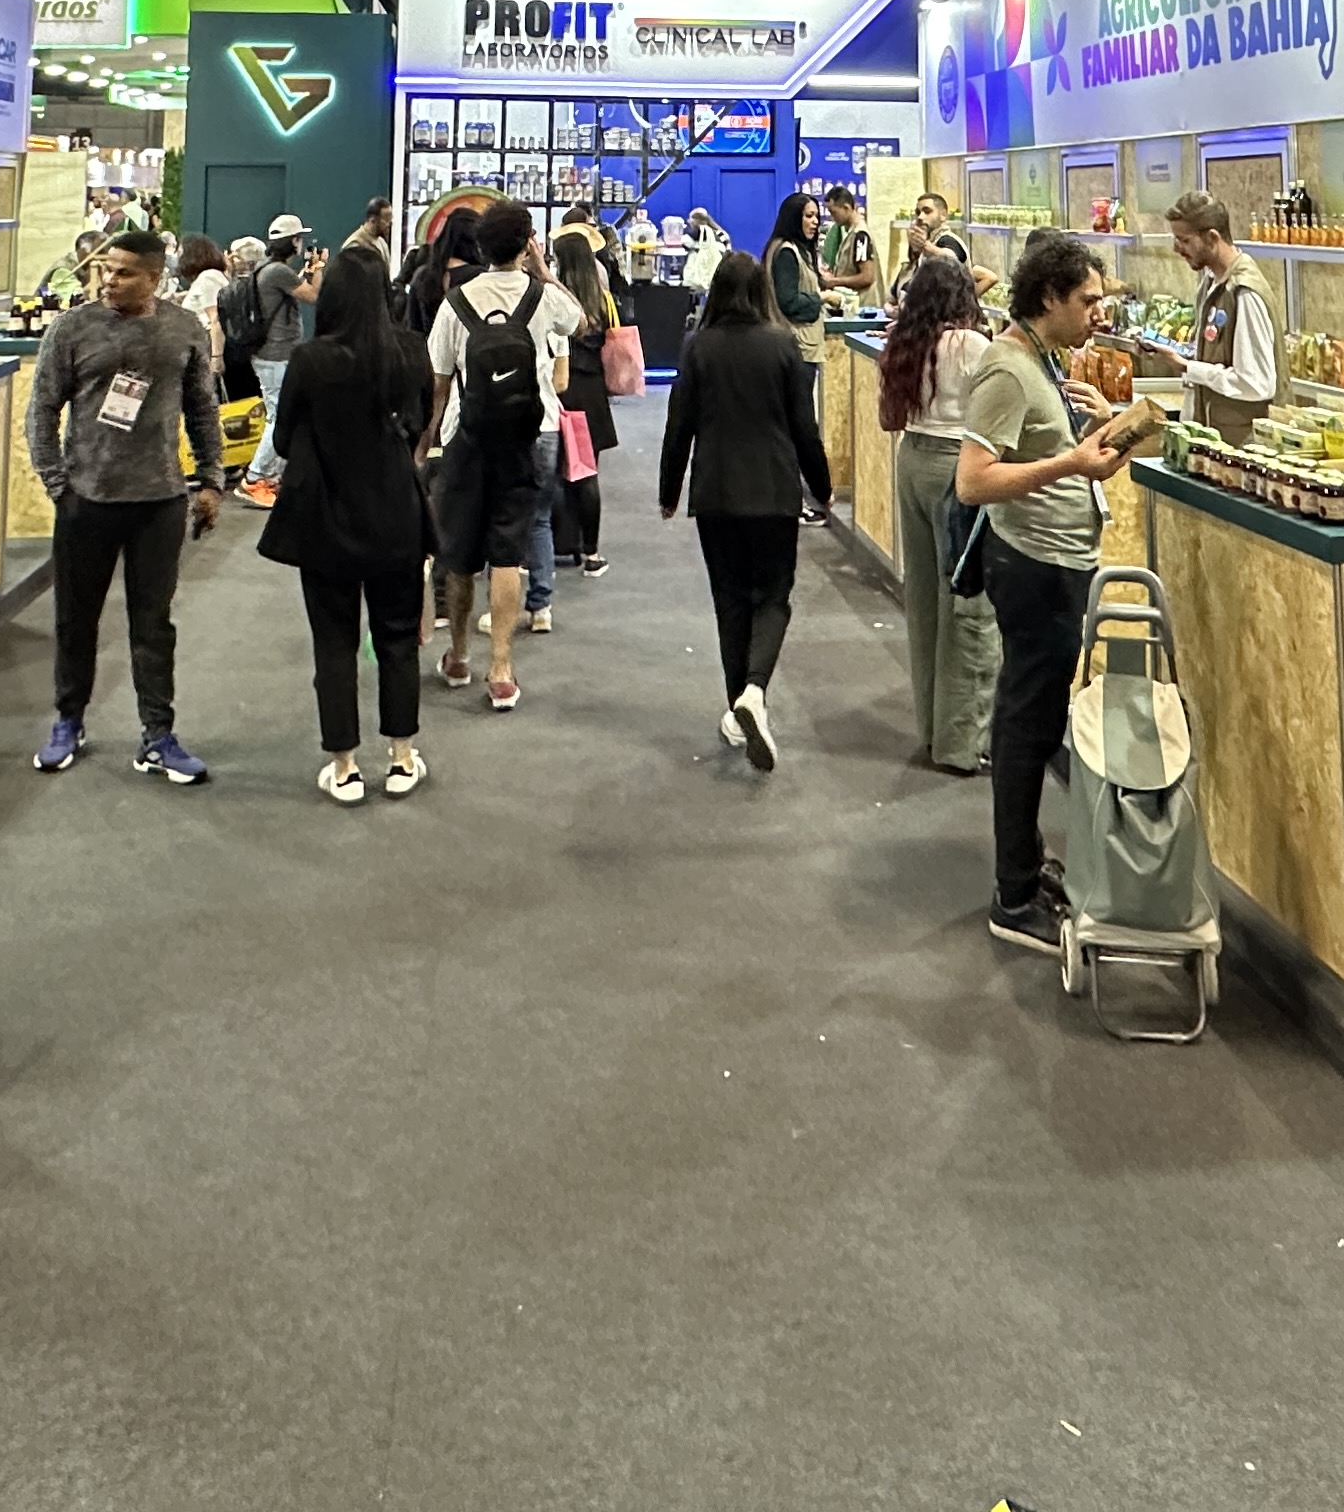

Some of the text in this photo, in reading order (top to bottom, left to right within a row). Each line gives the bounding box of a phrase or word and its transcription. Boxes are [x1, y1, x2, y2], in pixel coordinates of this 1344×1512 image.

[465, 0, 613, 40] PROFIT
[635, 26, 796, 47] CLINICAL LAB
[1082, 22, 1180, 89] FAMILIAR
[1187, 14, 1221, 67] DA
